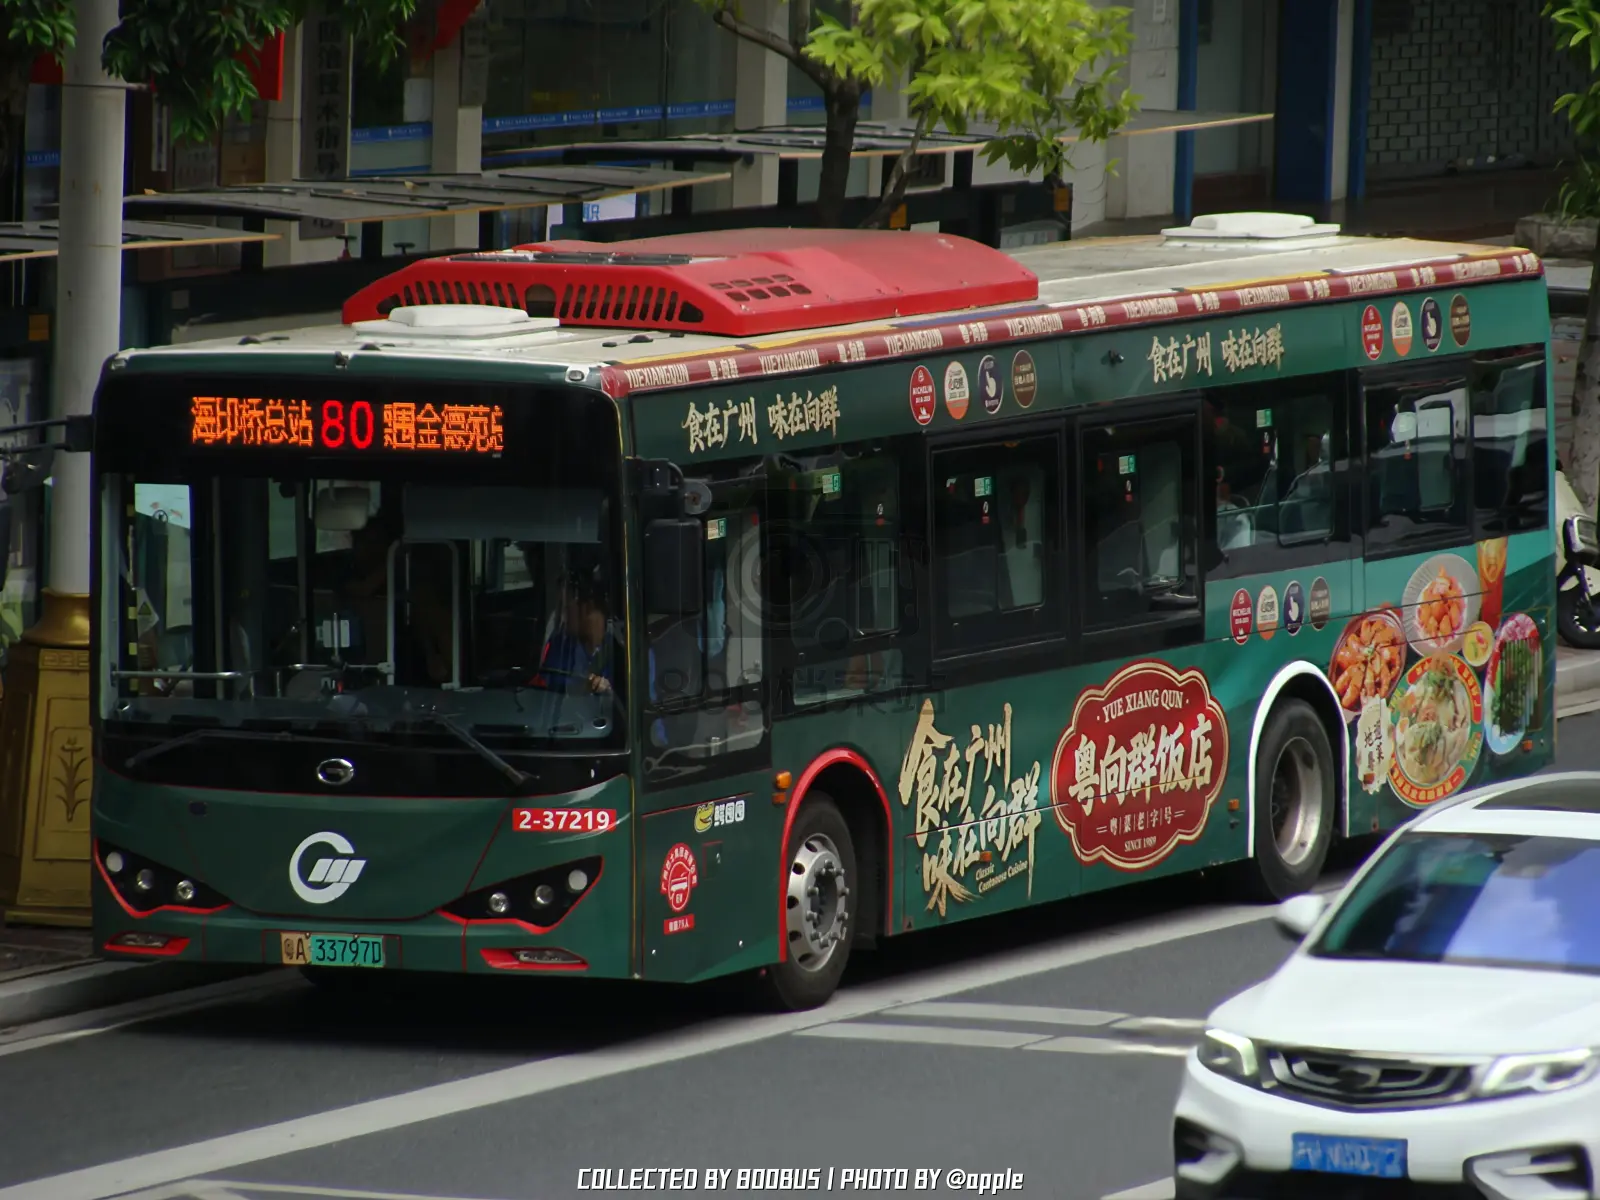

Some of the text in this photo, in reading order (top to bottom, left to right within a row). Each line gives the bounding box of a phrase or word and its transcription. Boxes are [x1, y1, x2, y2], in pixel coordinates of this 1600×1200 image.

[1147, 322, 1285, 384] 食在广州 味在向群
[321, 400, 374, 449] 80
[682, 385, 841, 454] 食在广州 味在向群
[1102, 689, 1184, 723] YUE XIANG QUN
[899, 697, 1013, 848] 食在广州
[1068, 713, 1213, 816] 粤向群饭店
[519, 810, 610, 830] 2-37219
[922, 760, 1042, 917] 味在向群
[1124, 838, 1143, 852] SINCE
